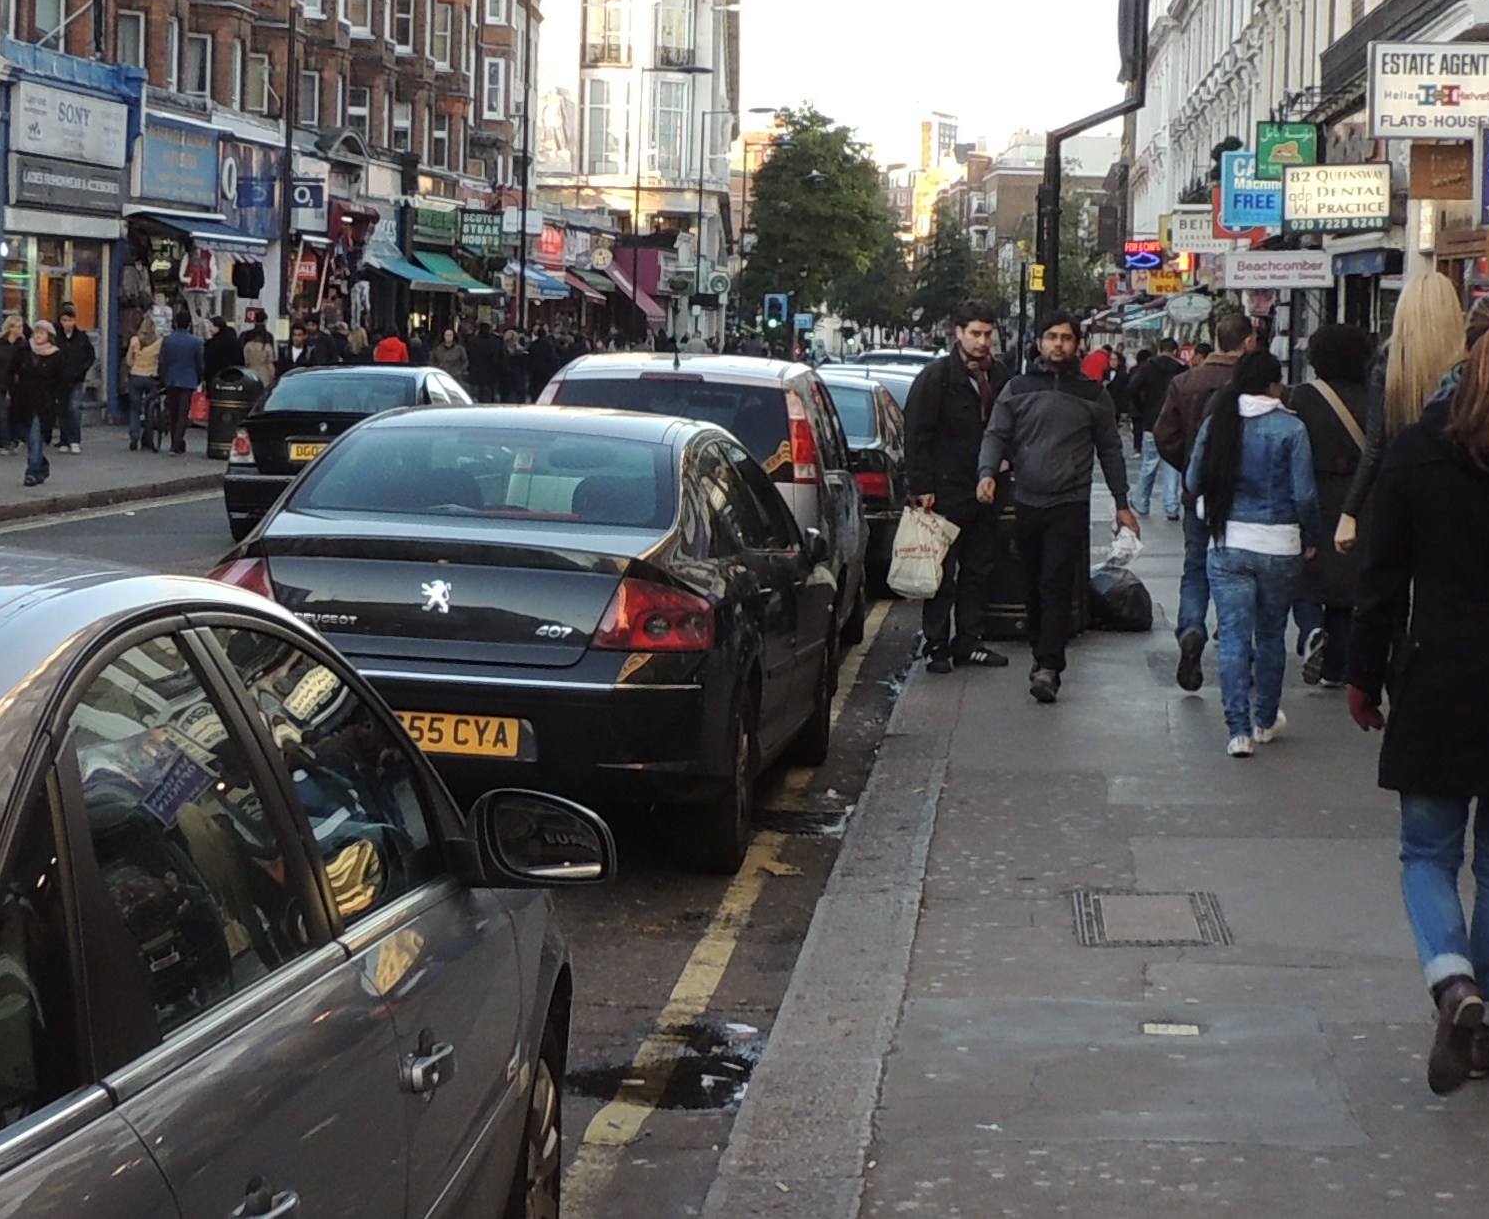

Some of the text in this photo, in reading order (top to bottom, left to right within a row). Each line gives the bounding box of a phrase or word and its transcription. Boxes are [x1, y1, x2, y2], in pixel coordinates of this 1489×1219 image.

[1381, 53, 1435, 75] ESTATE
[57, 101, 92, 126] SONY
[1380, 115, 1427, 128] FLATS
[1291, 171, 1311, 182] 82
[1234, 178, 1282, 190] Machin
[1317, 186, 1385, 197] DENTAL
[1233, 194, 1276, 210] FREE
[1317, 201, 1385, 214] PRACTICE
[463, 224, 500, 234] STEAK
[1179, 220, 1212, 230] BEIT
[1291, 217, 1384, 230] 020 7229 6248
[1236, 261, 1324, 272] Beachcomber
[535, 625, 573, 639] 407
[453, 718, 509, 749] CYA
